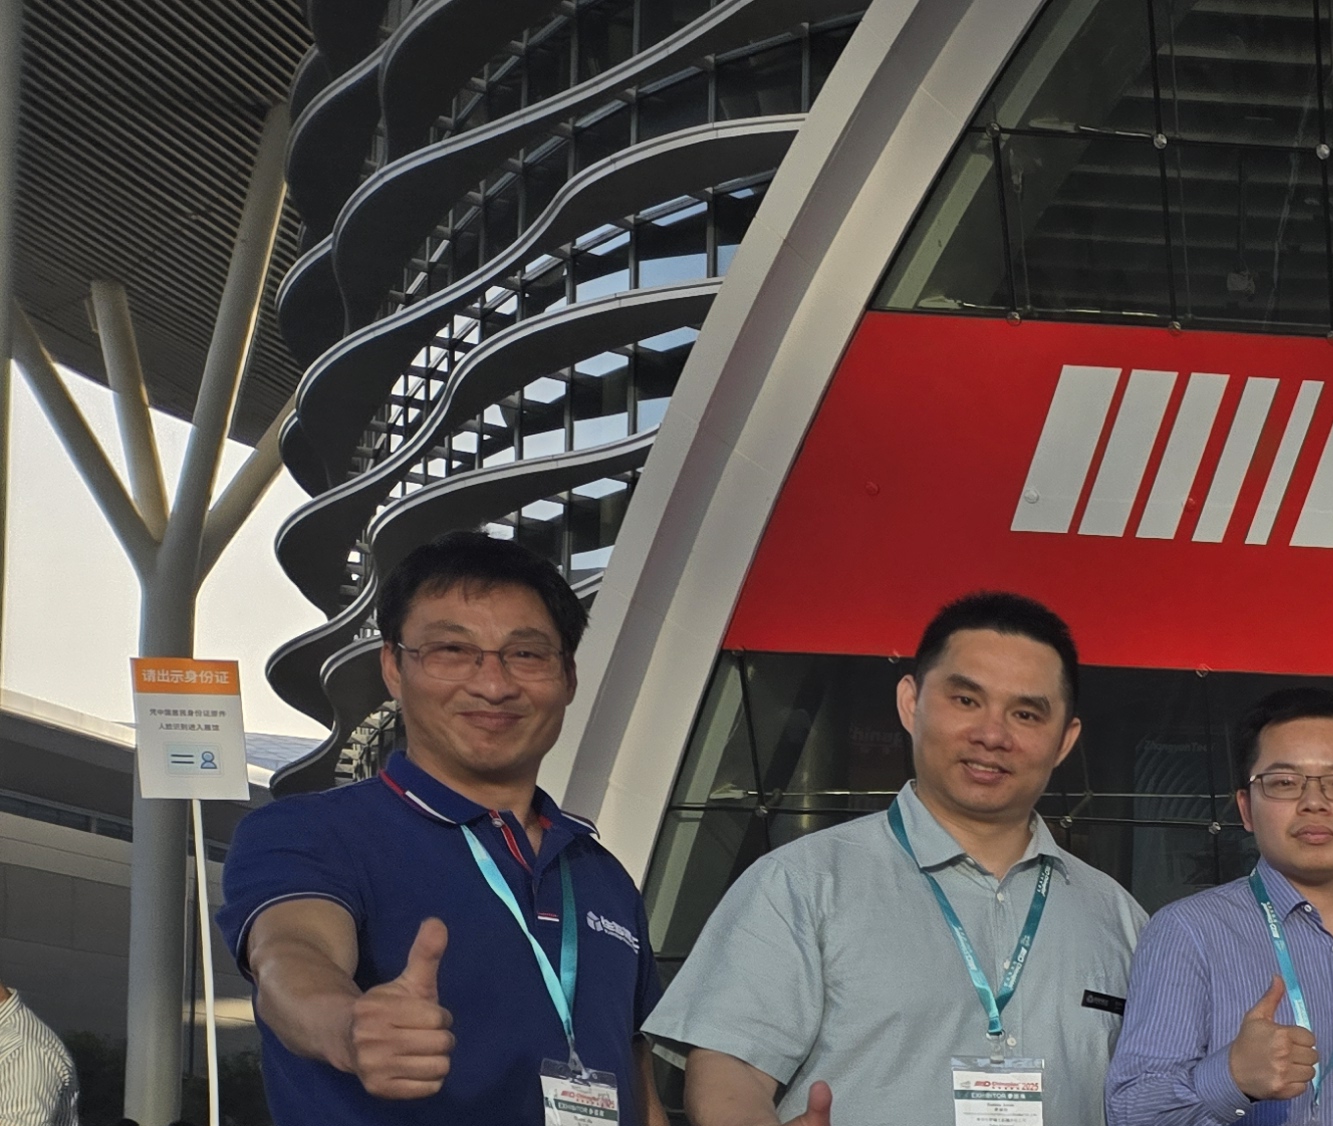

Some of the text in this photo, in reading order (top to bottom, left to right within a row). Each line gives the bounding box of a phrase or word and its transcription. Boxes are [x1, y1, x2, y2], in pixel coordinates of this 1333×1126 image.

[141, 668, 230, 684] 请出示身份证
